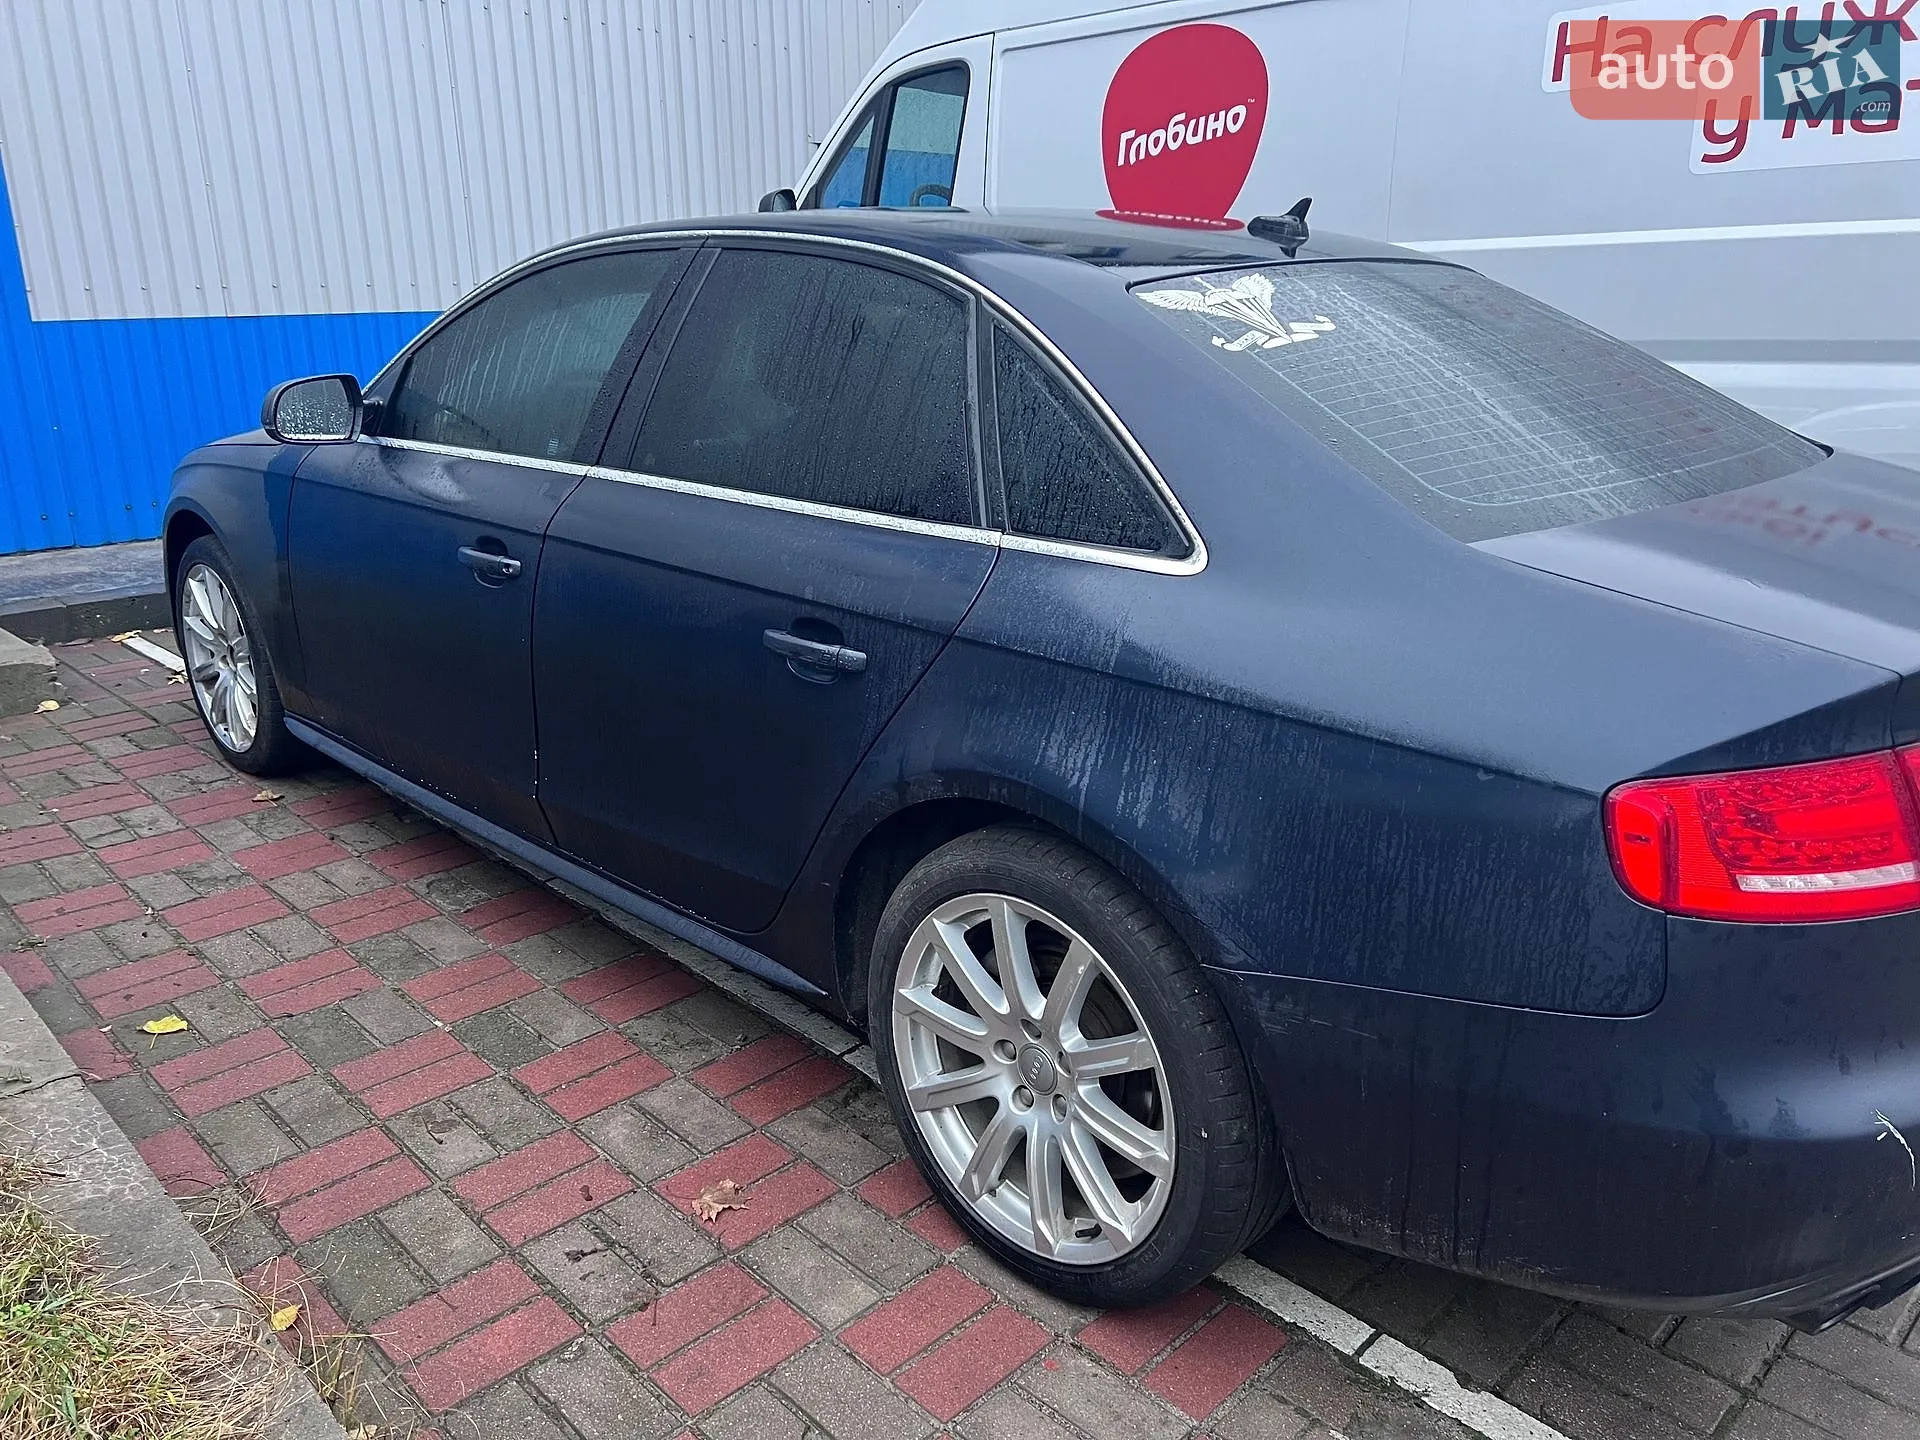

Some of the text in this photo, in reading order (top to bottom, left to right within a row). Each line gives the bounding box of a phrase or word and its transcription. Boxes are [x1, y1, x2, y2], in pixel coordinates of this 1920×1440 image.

[1551, 15, 1654, 83] На
[1117, 104, 1248, 167] Глобино
[1701, 95, 1752, 163] у
